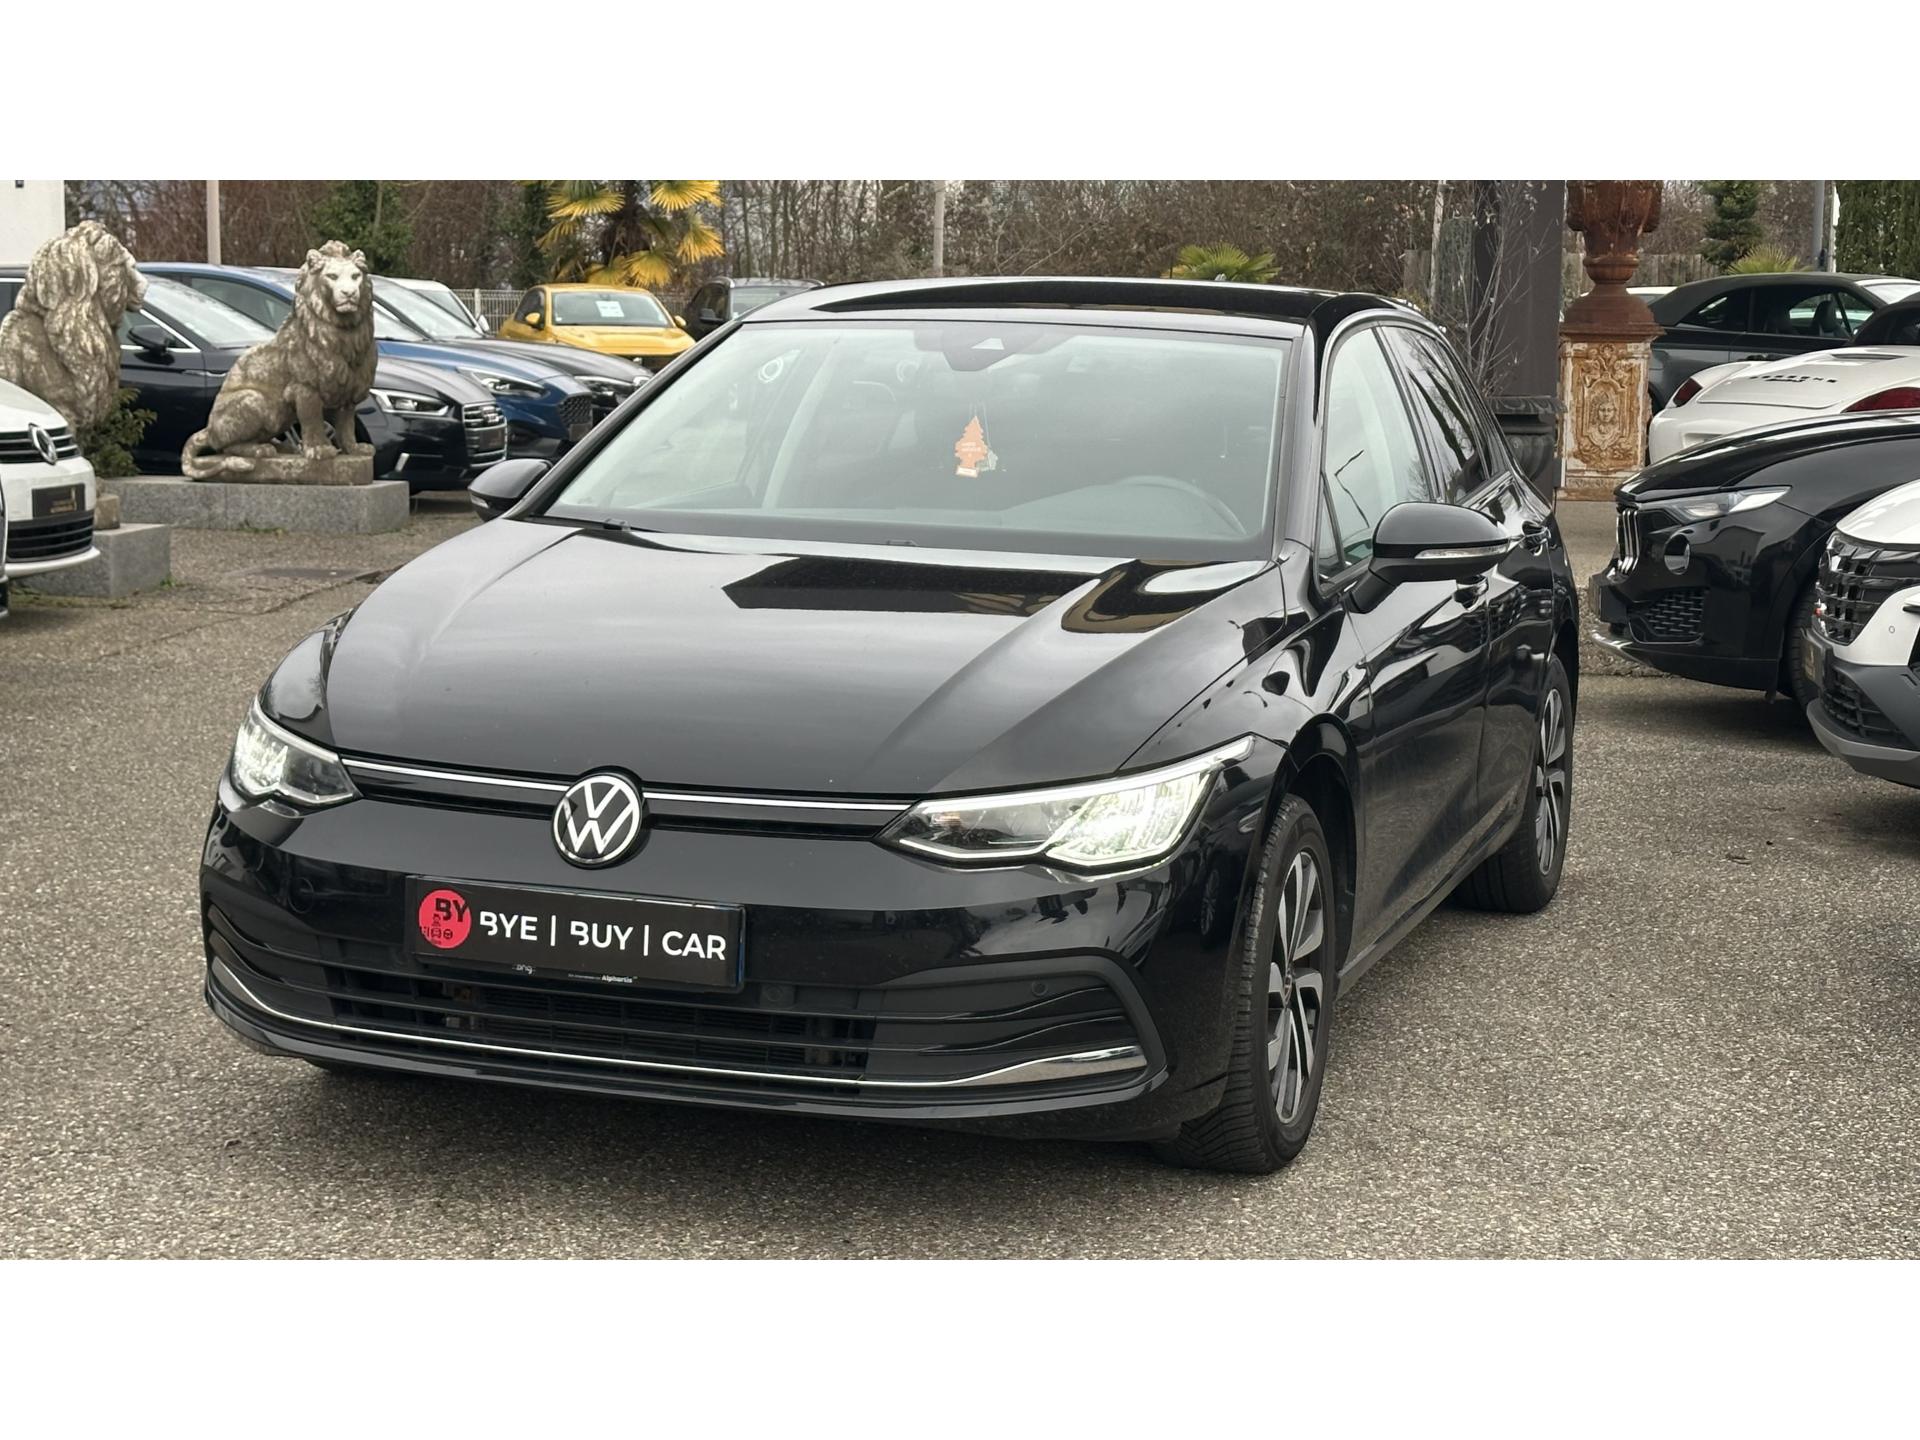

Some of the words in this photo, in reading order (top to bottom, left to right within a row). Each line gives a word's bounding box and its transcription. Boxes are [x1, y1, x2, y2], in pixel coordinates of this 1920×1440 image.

[480, 911, 538, 941] BYE
[570, 920, 634, 951] BUY
[661, 930, 727, 961] CAR
